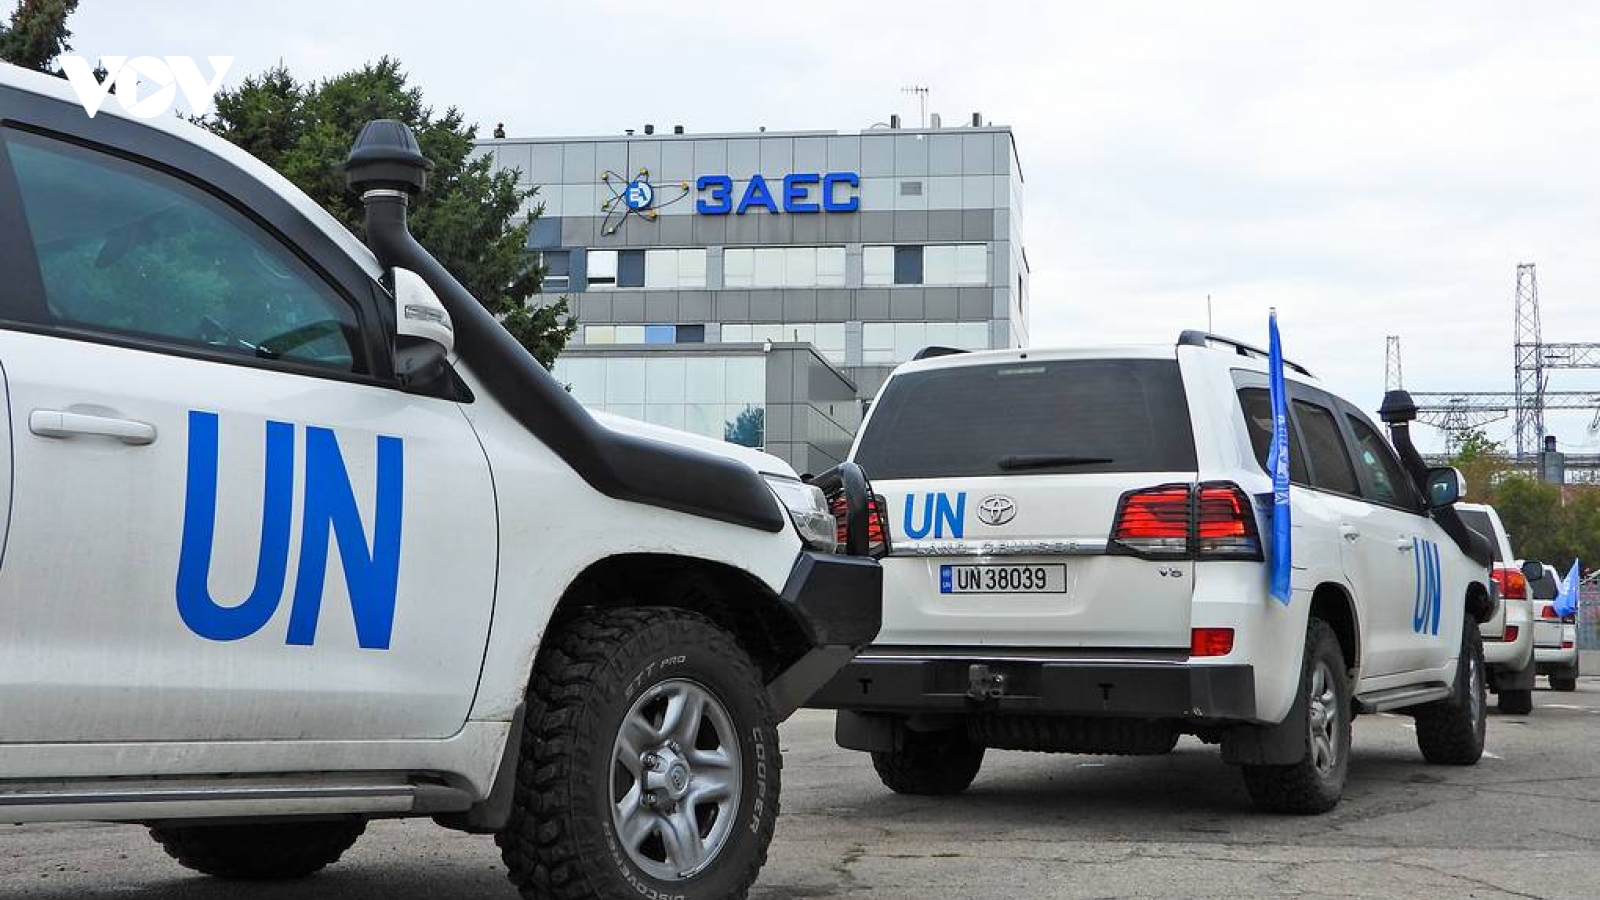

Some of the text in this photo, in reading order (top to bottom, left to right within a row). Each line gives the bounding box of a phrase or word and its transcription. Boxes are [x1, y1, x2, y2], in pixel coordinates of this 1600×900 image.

[176, 410, 404, 650] UN
[903, 492, 966, 539] UN
[957, 567, 1047, 590] UN 38039
[1412, 536, 1441, 636] UN
[660, 655, 686, 669] PRO
[750, 727, 767, 834] COOPER
